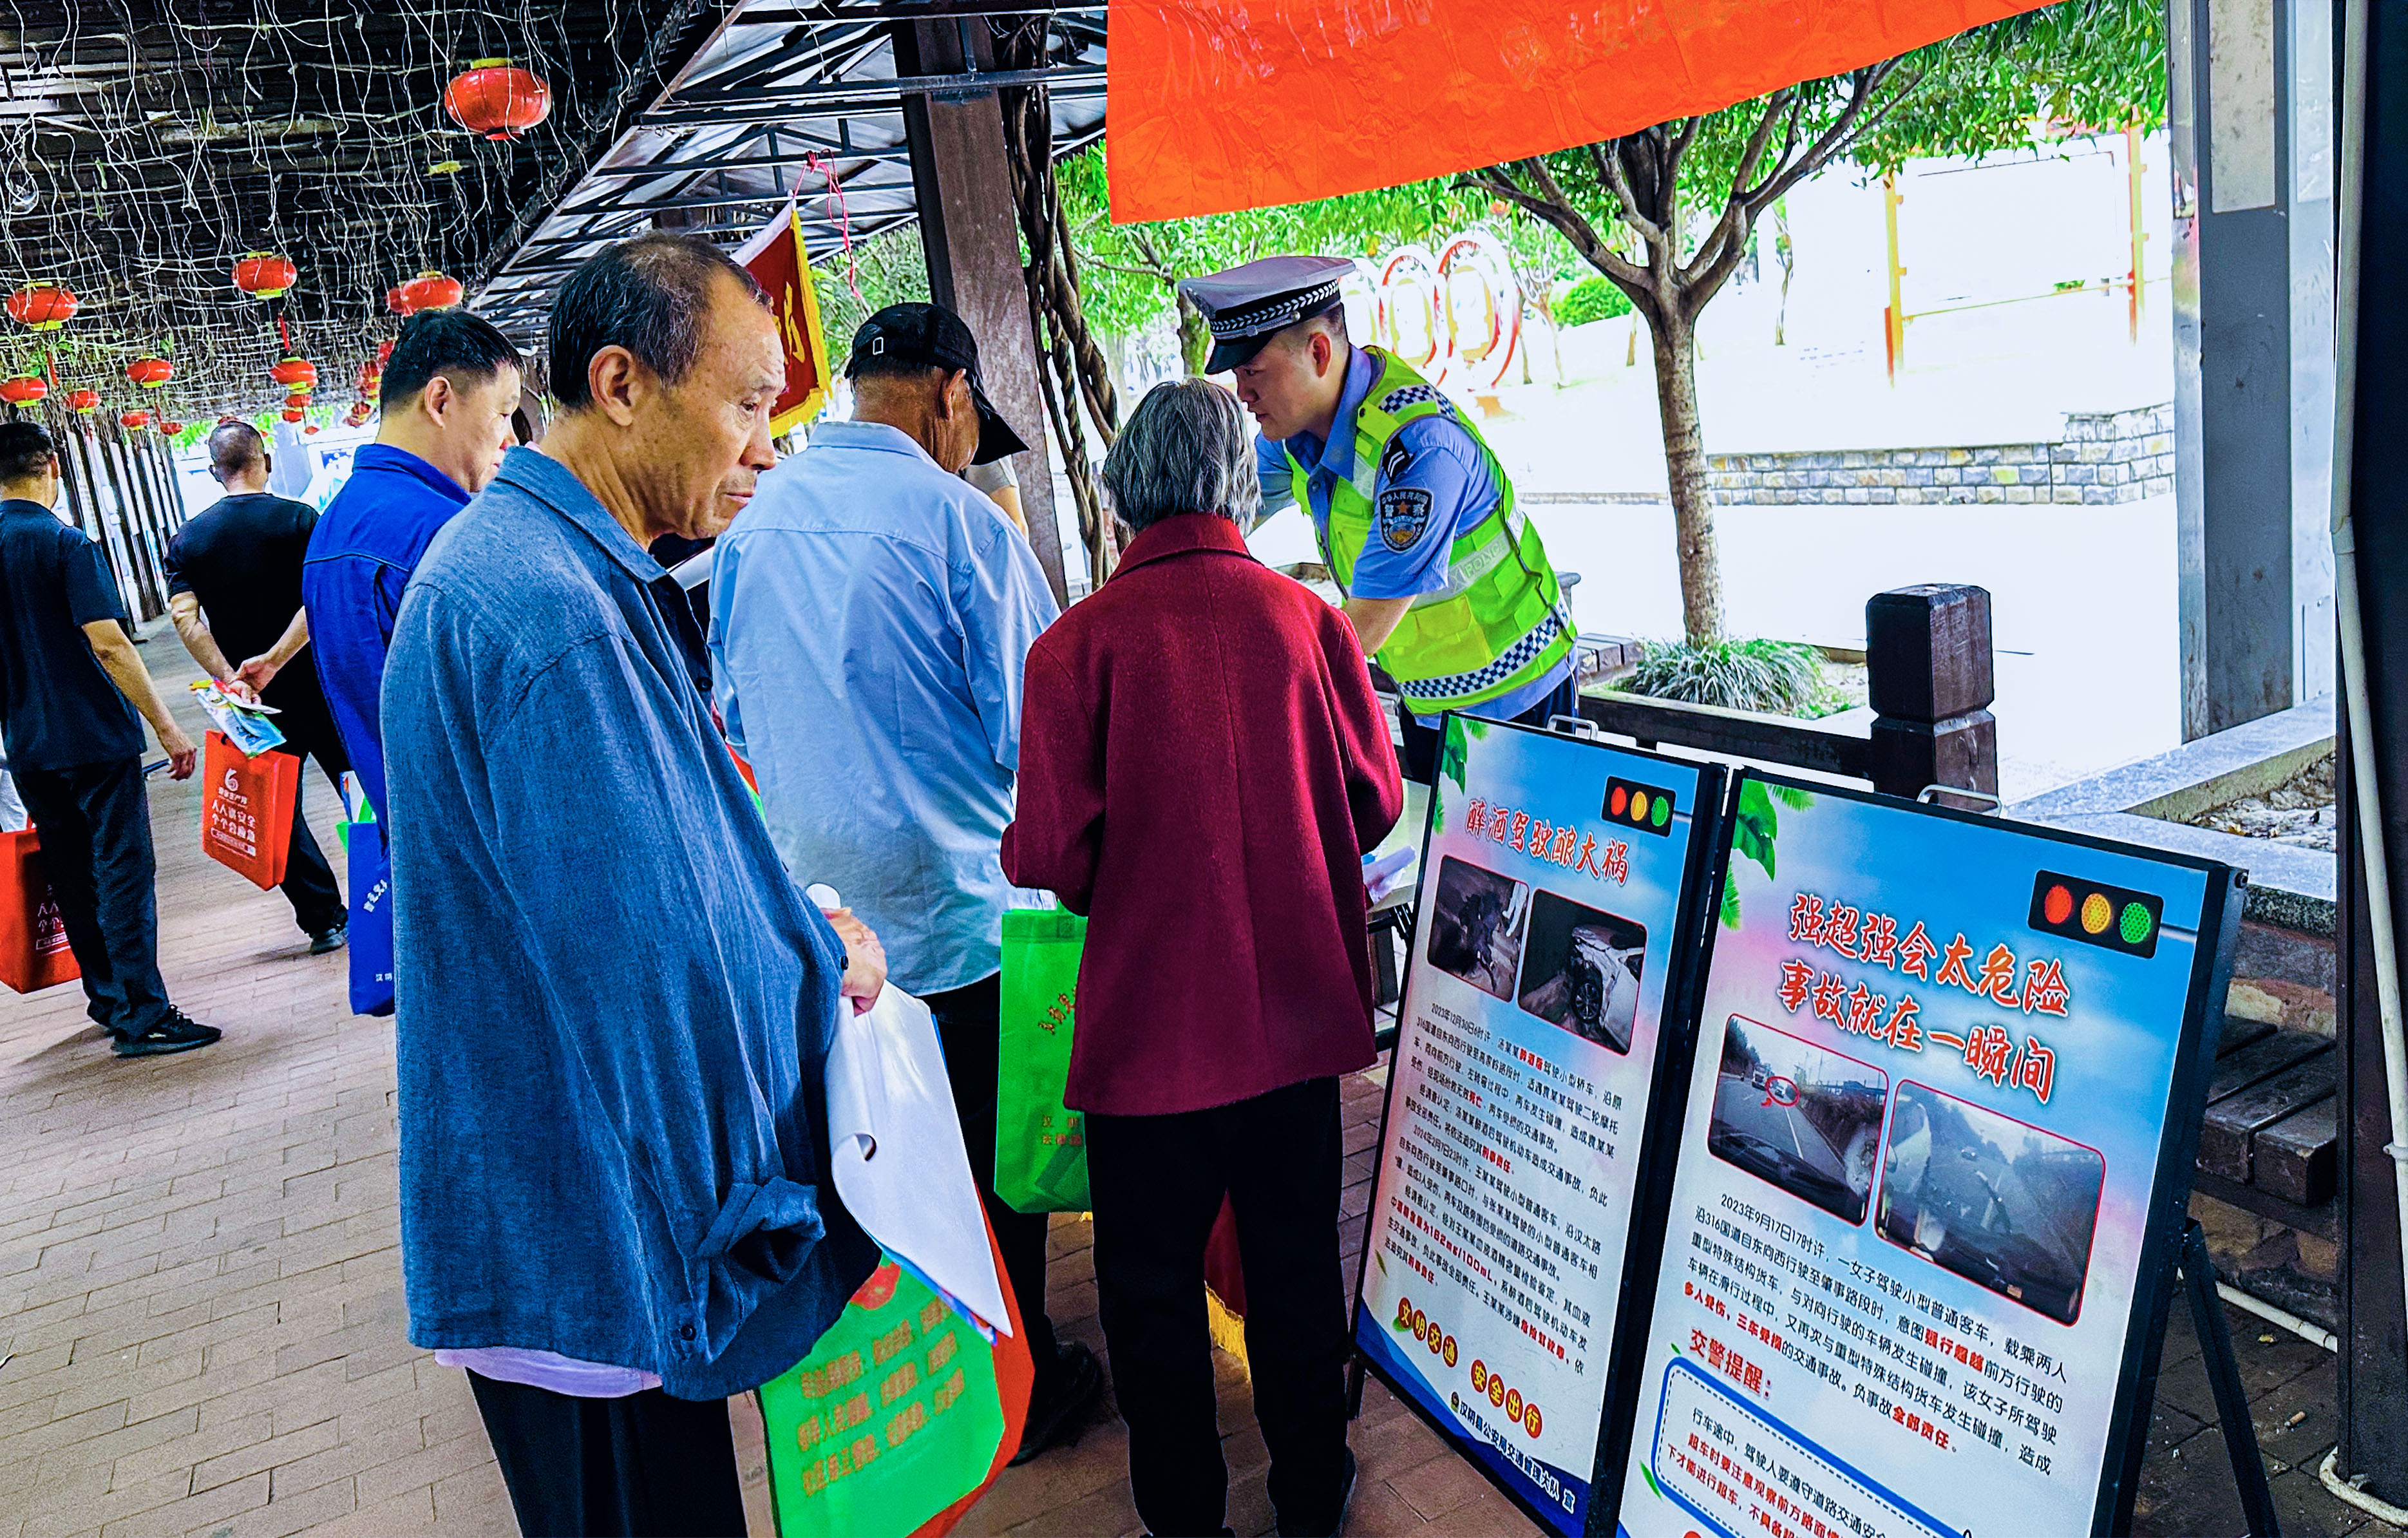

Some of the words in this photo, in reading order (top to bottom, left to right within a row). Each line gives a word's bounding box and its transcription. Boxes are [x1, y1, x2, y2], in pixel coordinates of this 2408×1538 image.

[1385, 504, 1394, 517] 警
[1412, 504, 1425, 517] 察
[1466, 800, 1629, 886] 醉酒驾驶酿大祸
[1789, 892, 2069, 1016] 强超强会太危险
[1778, 961, 2055, 1103] 事故就在一瞬间
[1399, 1301, 1455, 1363] 文明交通
[1474, 1363, 1541, 1435] 安全出行
[1689, 1328, 1773, 1401] 交警提醒：
[1459, 1400, 1560, 1499] 汉阴县公安局交通管理大队
